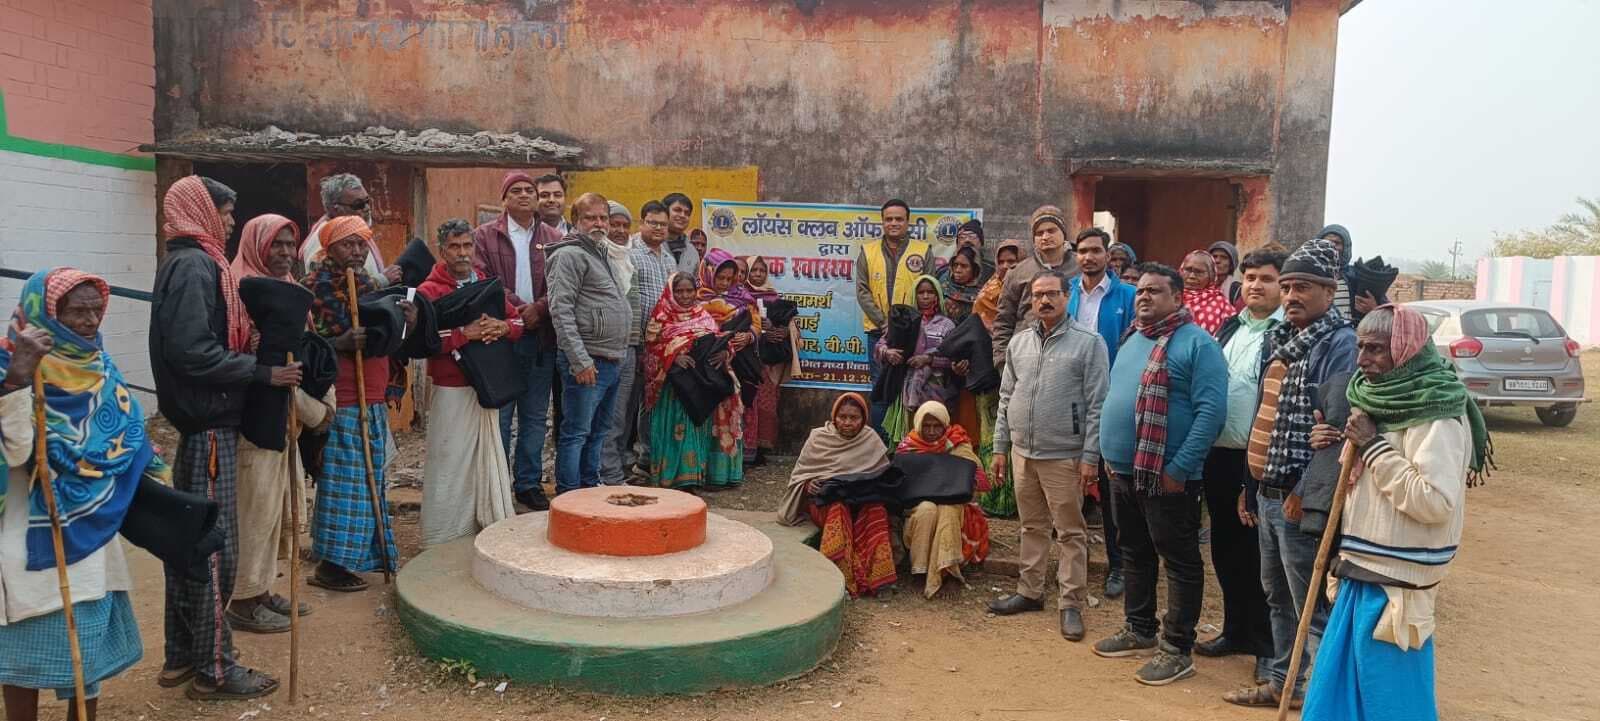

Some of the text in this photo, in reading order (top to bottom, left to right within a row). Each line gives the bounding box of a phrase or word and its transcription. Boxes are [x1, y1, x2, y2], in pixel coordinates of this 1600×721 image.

[742, 213, 793, 236] लॉयंस
[908, 217, 928, 240] सी
[819, 243, 850, 257] द्वारा
[792, 256, 855, 280] स्वास्थ्य
